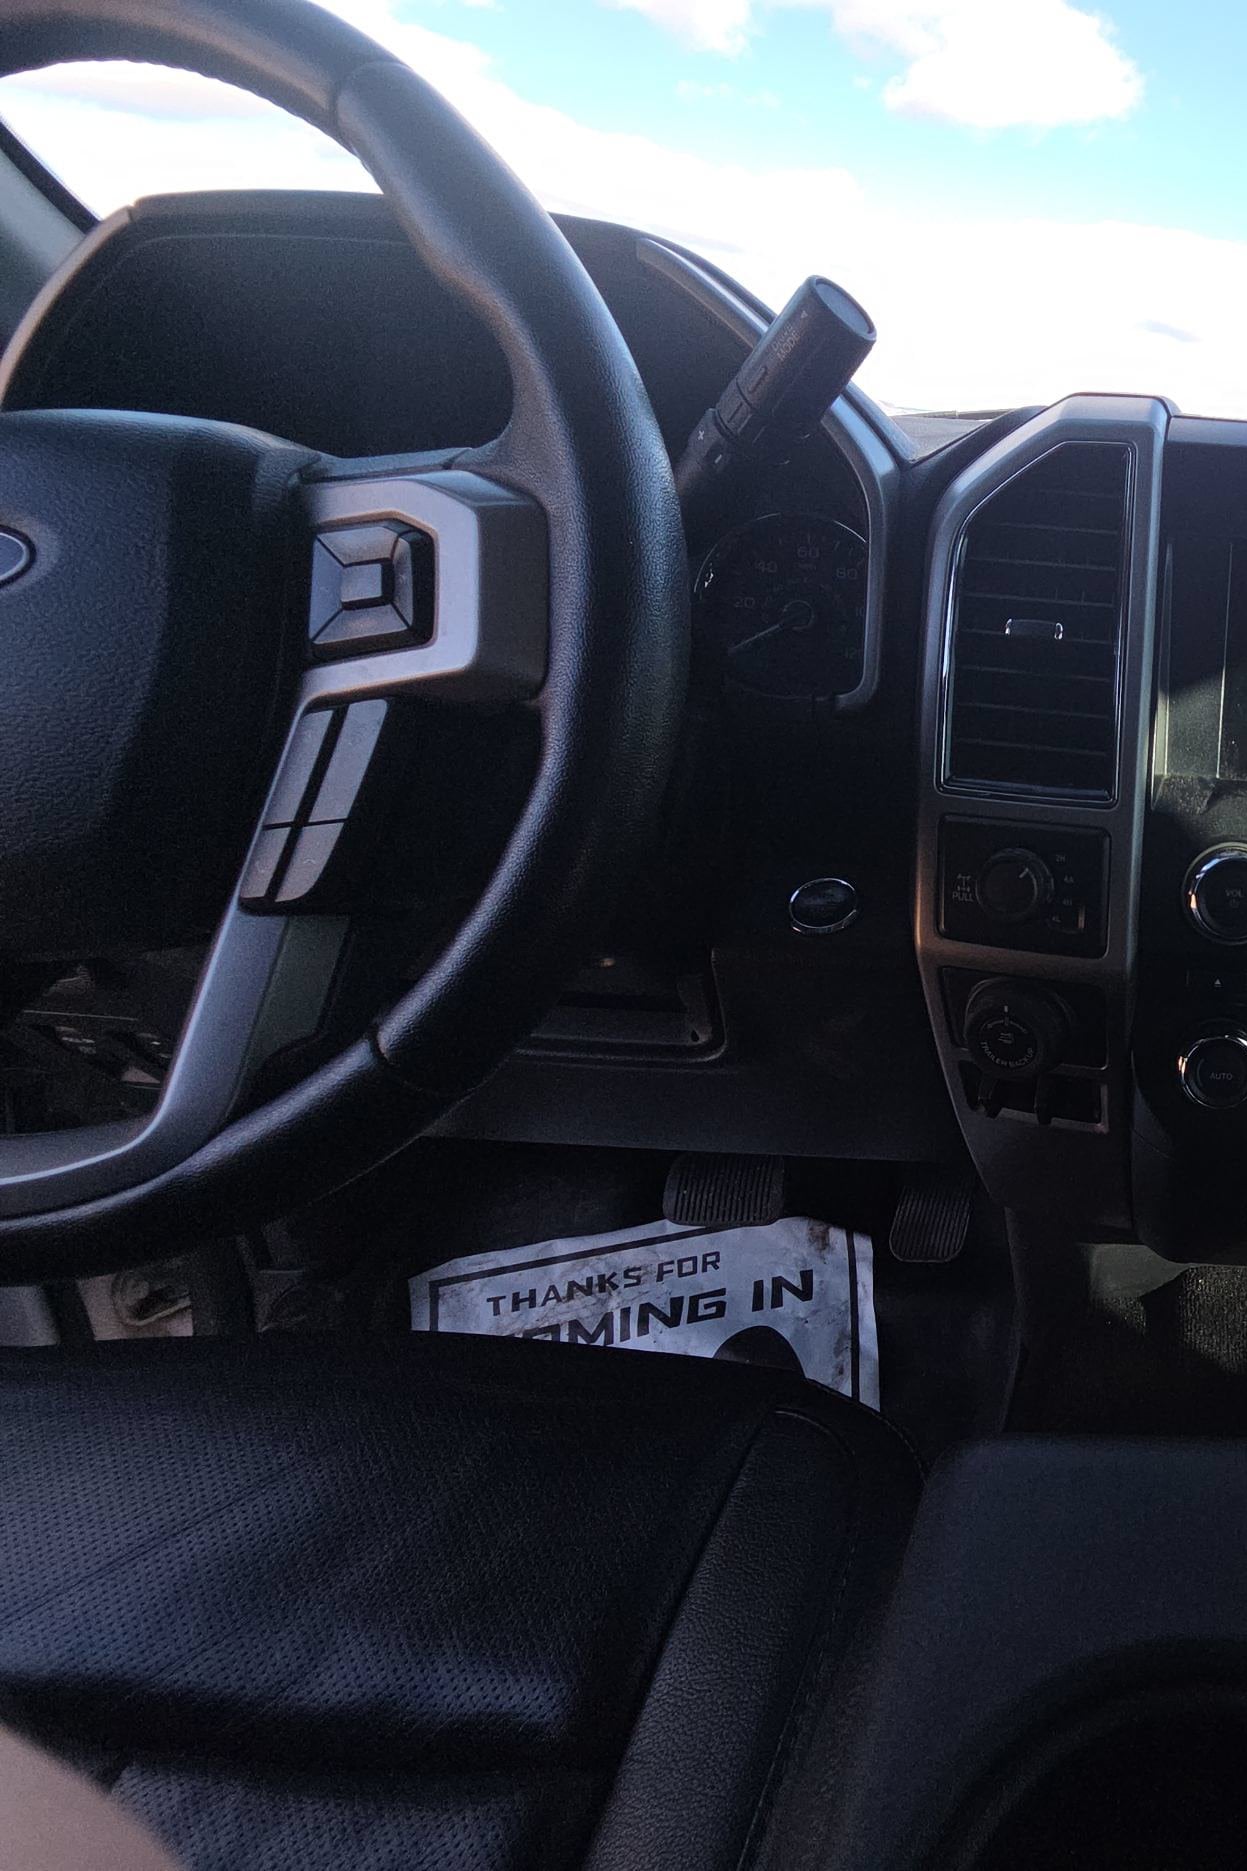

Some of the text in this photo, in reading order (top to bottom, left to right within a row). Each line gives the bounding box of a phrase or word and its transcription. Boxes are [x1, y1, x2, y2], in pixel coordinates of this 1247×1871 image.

[1224, 888, 1244, 898] VOL
[1209, 1071, 1233, 1081] AUTO
[486, 1251, 721, 1316] THANKS FOR
[508, 1269, 815, 1347] MING IN
